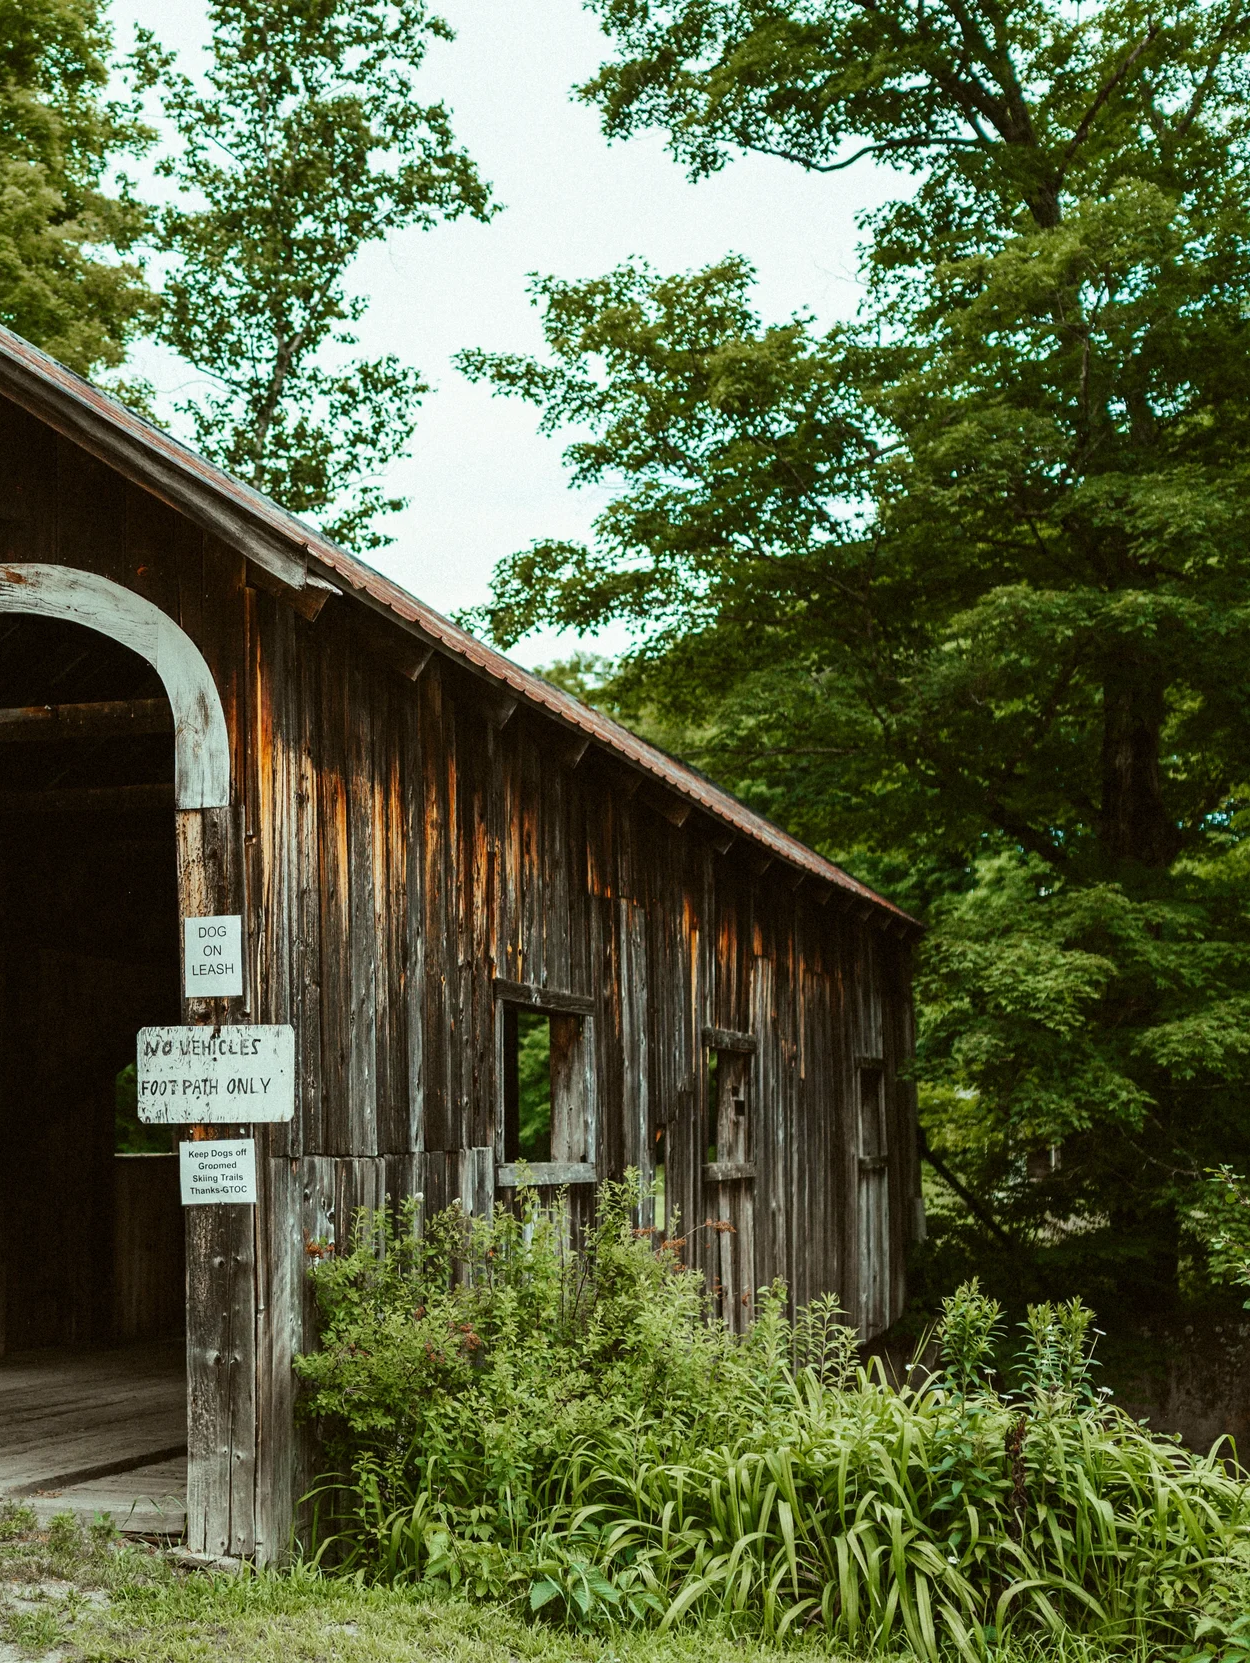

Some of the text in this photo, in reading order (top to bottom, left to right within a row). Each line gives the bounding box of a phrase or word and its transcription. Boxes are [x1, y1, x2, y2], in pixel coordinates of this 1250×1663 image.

[198, 925, 227, 938] DOG
[203, 945, 222, 957] ON
[192, 963, 234, 976] LEASH
[144, 1038, 261, 1056] NO VEHICLES
[227, 1077, 271, 1094] ONLY
[188, 1148, 247, 1159] Keep Dogs off
[198, 1161, 237, 1170] Groomed
[192, 1173, 244, 1183] Skiing Trails
[190, 1185, 248, 1195] Thanks-GTOC
